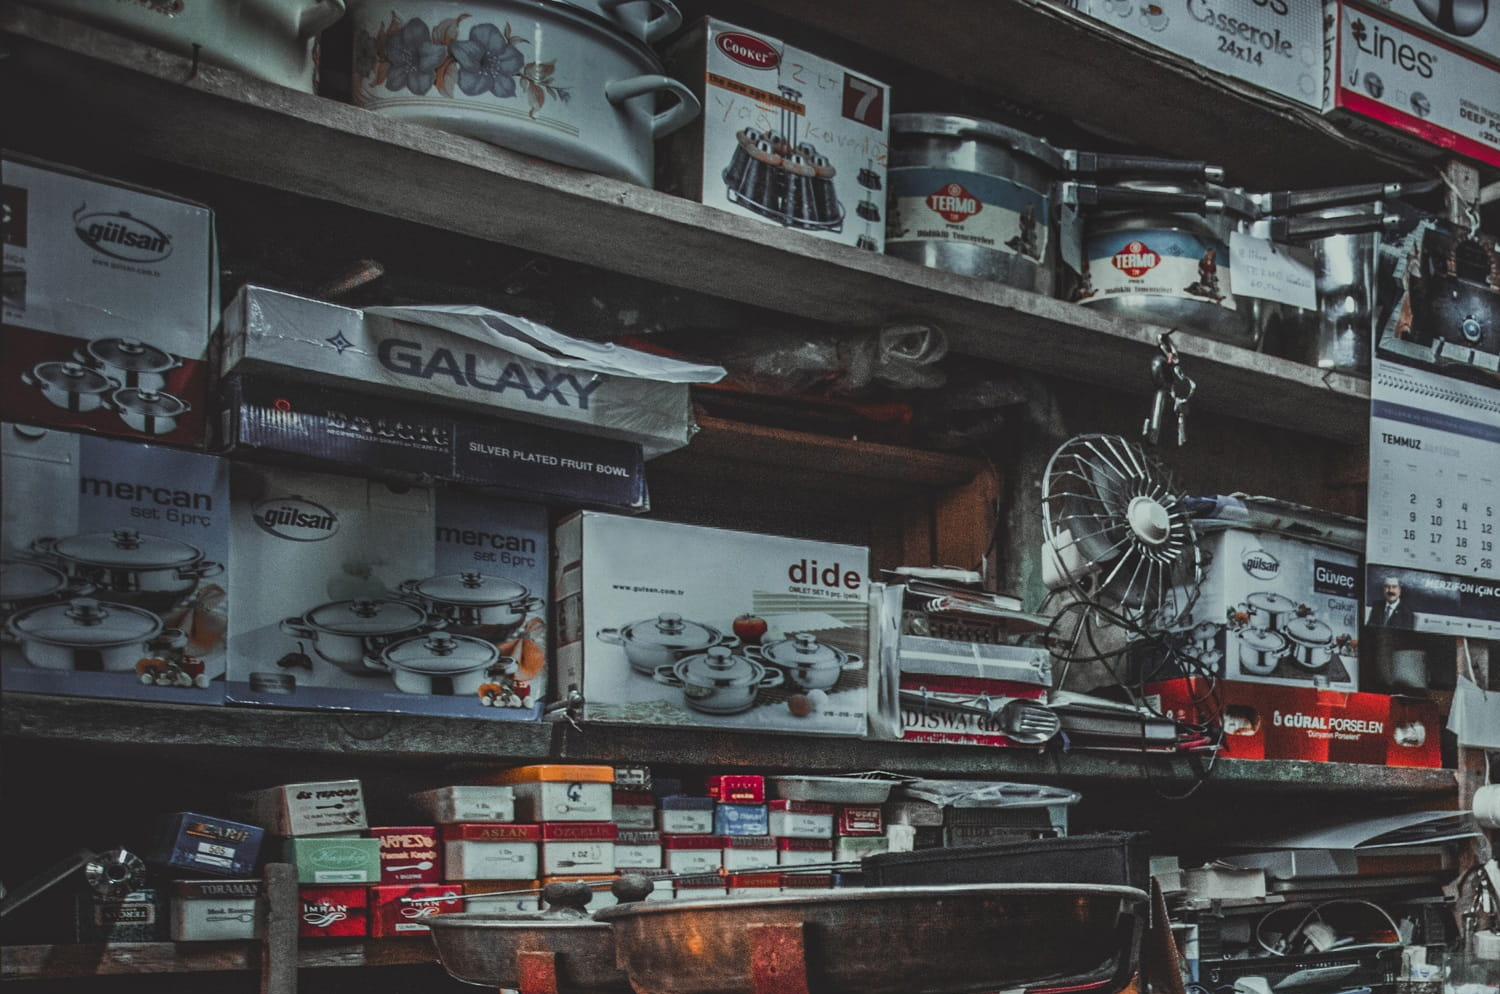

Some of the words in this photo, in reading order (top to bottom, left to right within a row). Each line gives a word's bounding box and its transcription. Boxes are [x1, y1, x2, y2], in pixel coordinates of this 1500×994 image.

[1187, 0, 1293, 58] Casserole
[723, 38, 769, 63] Cooker
[1218, 35, 1263, 66] 24x14
[850, 78, 878, 121] 7
[1459, 108, 1486, 126] DEEP
[931, 195, 976, 213] TERMO
[88, 221, 169, 253] gülsan
[1116, 253, 1155, 268] TERMO
[377, 337, 605, 410] GALAXY
[1382, 433, 1421, 450] TEMMUZ
[469, 441, 510, 457] SILVER
[513, 450, 558, 466] PLATED
[561, 458, 594, 472] FRUIT
[596, 464, 630, 478] BOWL
[81, 476, 212, 511] mercan
[130, 507, 161, 520] set
[1410, 494, 1416, 504] 2
[1436, 498, 1442, 508] 3
[1461, 503, 1468, 513] 4
[1486, 507, 1492, 517] 5
[265, 507, 336, 530] gülsan
[1409, 512, 1416, 522] 9
[1430, 515, 1442, 526] 10
[1456, 520, 1467, 530] 11
[1481, 524, 1492, 534] 12
[437, 526, 537, 554] mercan
[1404, 530, 1415, 540] 16
[1430, 533, 1442, 544] 17
[1481, 541, 1492, 551] 19
[473, 550, 497, 562] set
[1247, 556, 1279, 573] gülsan
[1455, 555, 1467, 566] 25
[1481, 558, 1492, 569] 26
[788, 558, 861, 589] dide
[1316, 567, 1354, 588] Güveç
[1285, 715, 1327, 730] GÜRAL
[1328, 718, 1384, 734] PORSELEN
[481, 828, 528, 838] ASLAN
